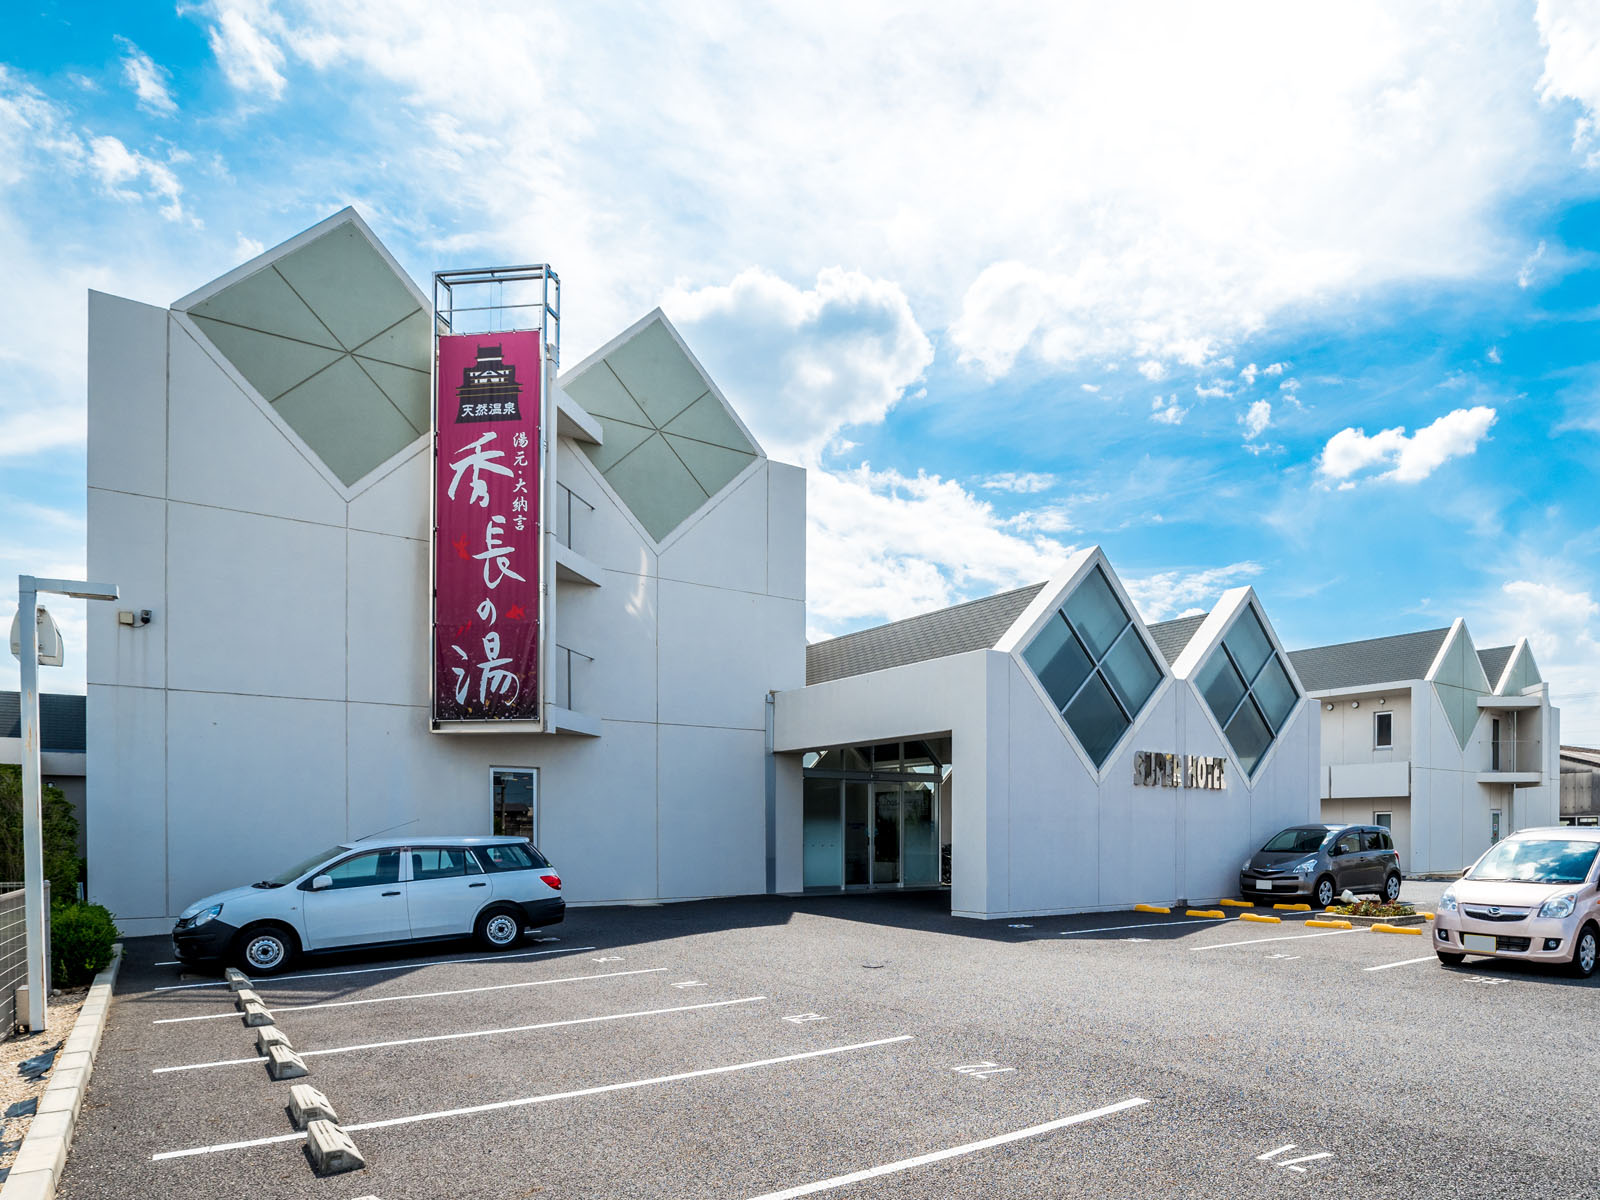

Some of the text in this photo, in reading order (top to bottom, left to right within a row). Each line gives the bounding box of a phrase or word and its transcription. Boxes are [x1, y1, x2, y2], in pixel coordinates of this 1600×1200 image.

[461, 402, 516, 418] 天然温泉
[1133, 751, 1182, 787] SUPER
[782, 1012, 829, 1024] 73
[951, 1061, 1016, 1079] 72
[1255, 1144, 1335, 1173] 71
